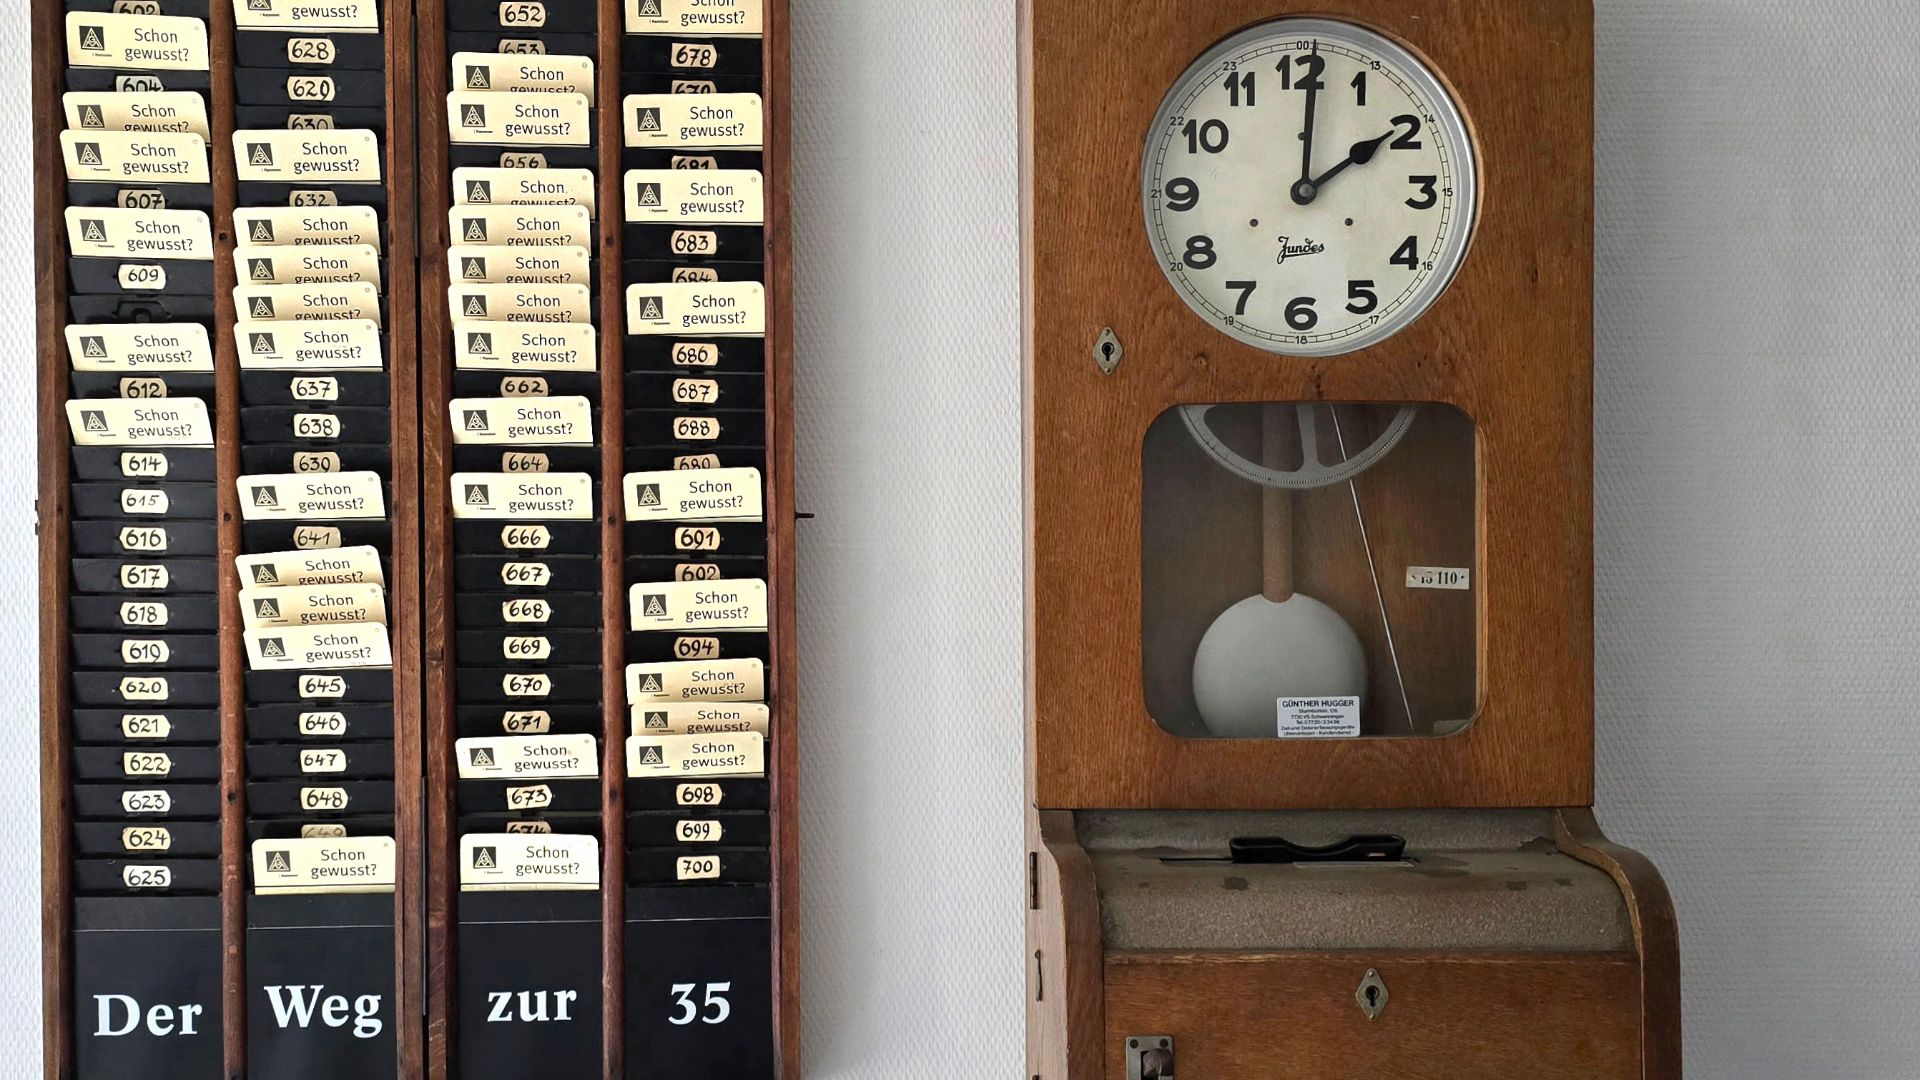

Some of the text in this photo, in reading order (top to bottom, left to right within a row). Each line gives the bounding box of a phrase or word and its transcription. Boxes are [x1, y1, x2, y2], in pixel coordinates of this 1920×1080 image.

[292, 5, 357, 20] gewusst?
[505, 5, 542, 23] 652
[681, 11, 745, 26] gewusst?
[135, 28, 177, 43] Schon
[292, 40, 329, 60] 628
[1296, 40, 1309, 51] 00
[125, 48, 188, 61] gewusst?
[674, 46, 712, 68] 678
[1223, 61, 1237, 71] 23
[1275, 55, 1325, 90] 12
[1370, 61, 1381, 70] 13
[521, 67, 563, 80] Schon
[1224, 72, 1255, 106] 11
[1350, 72, 1366, 106] 1
[132, 104, 175, 117] Schon
[515, 105, 558, 118] Schon
[690, 106, 732, 119] Schon
[1170, 116, 1184, 126] 22
[1423, 114, 1435, 123] 14
[506, 123, 570, 137] gewusst?
[680, 124, 744, 138] gewusst?
[1182, 119, 1229, 153] 10
[1389, 115, 1421, 149] 2
[131, 144, 175, 156] Schon
[303, 142, 347, 155] Schon
[123, 162, 188, 175] gewusst?
[294, 159, 359, 174] gewusst?
[521, 180, 564, 193] Schon
[691, 182, 733, 195] Schon
[1151, 189, 1161, 198] 21
[1404, 176, 1437, 209] 3
[1165, 177, 1199, 212] 9
[681, 200, 744, 215] gewusst?
[135, 221, 180, 234] Schon
[303, 218, 347, 231] Schon
[517, 217, 559, 230] Schon
[127, 239, 192, 251] gewusst?
[675, 234, 708, 252] 683
[1183, 235, 1217, 270] 8
[1389, 236, 1419, 270] 4
[303, 257, 348, 269] Schon
[516, 257, 559, 269] Schon
[1170, 262, 1183, 272] 20
[1422, 261, 1433, 270] 16
[128, 268, 158, 282] 609
[303, 294, 348, 306] Schon
[517, 294, 560, 307] Schon
[693, 295, 734, 307] Schon
[1225, 281, 1256, 315] 7
[1345, 280, 1377, 314] 5
[683, 311, 746, 327] gewusst?
[1224, 316, 1234, 326] 19
[1284, 297, 1318, 331] 6
[1369, 315, 1379, 324] 17
[134, 335, 179, 347] Schon
[304, 331, 348, 343] Schon
[522, 334, 565, 346] Schon
[1295, 336, 1307, 345] 18
[128, 351, 191, 365] gewusst?
[296, 346, 361, 361] gewusst?
[512, 351, 576, 363] gewusst?
[127, 381, 162, 398] 612
[297, 380, 331, 397] 637
[505, 381, 543, 393] 662
[678, 382, 710, 401] 687
[135, 409, 178, 421] Schon
[518, 408, 560, 420] Schon
[128, 424, 191, 439] gewusst?
[299, 418, 333, 437] 638
[508, 423, 572, 438] gewusst?
[678, 419, 710, 436] 688
[129, 456, 161, 471] 614
[509, 457, 542, 470] 664
[307, 484, 351, 495] Schon
[519, 484, 562, 495] Schon
[690, 481, 731, 493] Schon
[127, 494, 159, 506] 615
[299, 498, 363, 513] gewusst?
[509, 499, 573, 513] gewusst?
[680, 496, 743, 512] gewusst?
[126, 529, 161, 547] 616
[298, 529, 330, 546] 641
[508, 528, 540, 545] 666
[680, 531, 713, 548] 691
[305, 560, 350, 571] Schon
[127, 568, 160, 584] 617
[506, 565, 542, 581] 667
[309, 595, 353, 607] Schon
[696, 591, 737, 604] Schon
[128, 606, 157, 623] 618
[299, 609, 368, 625] gewusst?
[509, 602, 543, 619] 668
[686, 607, 748, 623] gewusst?
[314, 634, 358, 646] Schon
[509, 639, 540, 654] 669
[129, 644, 161, 664] 619
[306, 647, 371, 663] gewusst?
[679, 639, 714, 657] 694
[692, 670, 734, 681] Schon
[126, 682, 161, 693] 620
[306, 678, 340, 693] 645
[510, 677, 542, 693] 670
[682, 683, 745, 698] gewusst?
[1282, 700, 1319, 708] GÜNTHER
[698, 710, 739, 720] Schon
[129, 717, 157, 733] 621
[507, 714, 541, 731] 671
[524, 745, 566, 756] Schon
[692, 743, 734, 753] Schon
[130, 755, 166, 772] 622
[304, 754, 337, 766] 647
[515, 758, 578, 772] gewusst?
[683, 755, 745, 770] gewusst?
[307, 790, 342, 808] 648
[512, 789, 547, 806] 673
[682, 786, 714, 802] 698
[129, 794, 164, 810] 623
[683, 823, 709, 839] 699
[129, 830, 167, 847] 624
[321, 849, 365, 861] Schon
[527, 846, 568, 858] Schon
[311, 864, 376, 879] gewusst?
[516, 863, 579, 876] gewusst?
[683, 860, 713, 874] 700
[127, 870, 167, 887] 625
[93, 981, 731, 1038] Der Weg zur 35
